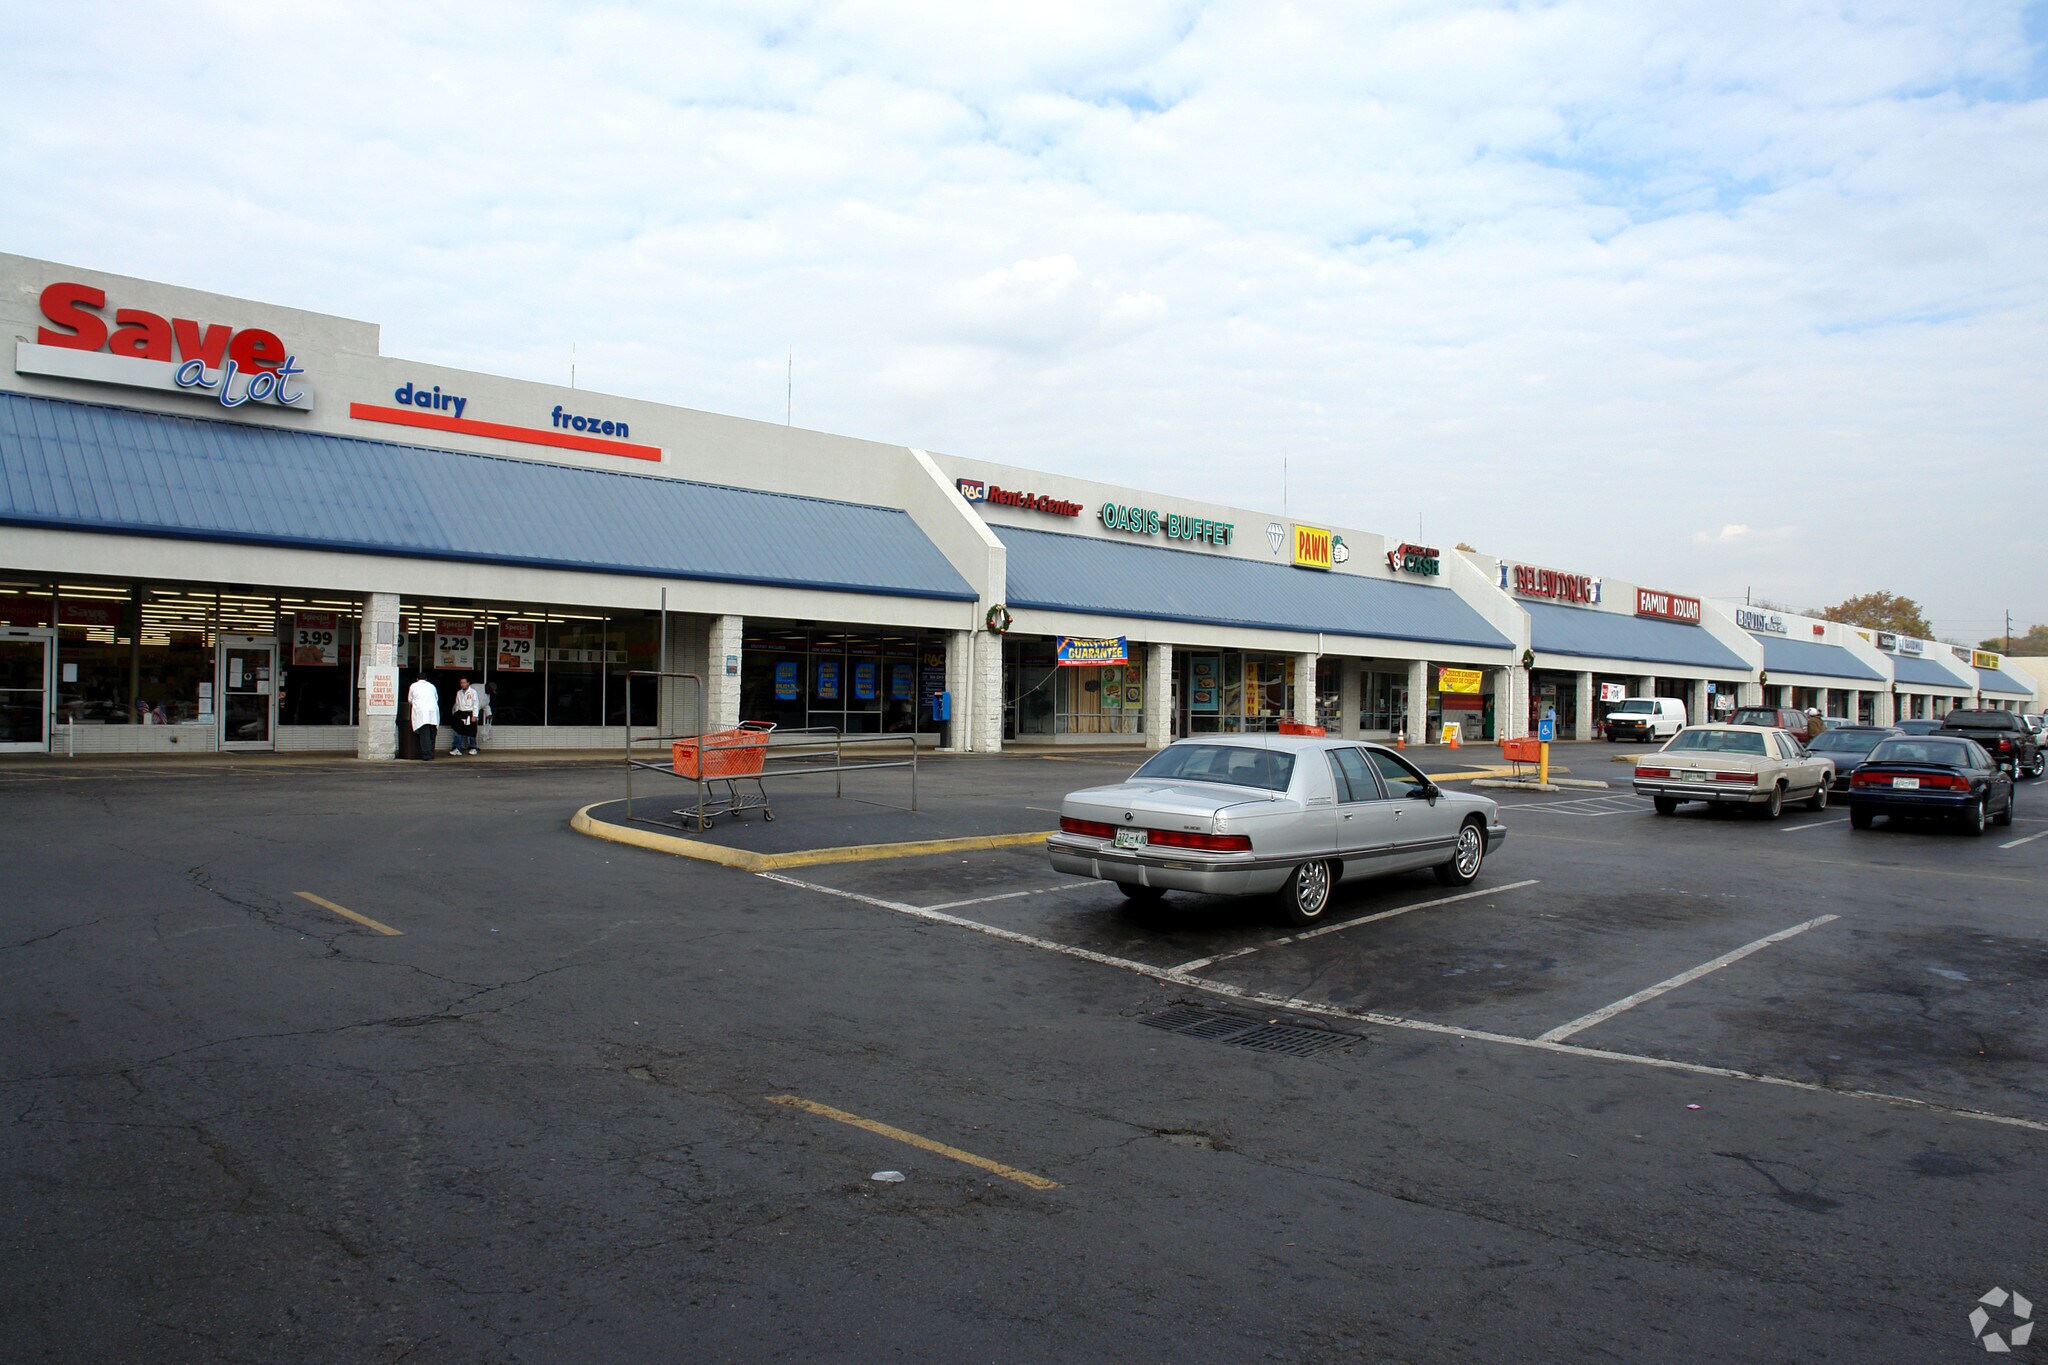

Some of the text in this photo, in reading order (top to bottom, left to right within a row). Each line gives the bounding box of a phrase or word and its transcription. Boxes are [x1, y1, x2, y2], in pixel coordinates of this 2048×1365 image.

[38, 282, 286, 377] Save
[176, 358, 219, 388] a
[394, 382, 467, 419] dairy
[551, 405, 629, 438] frozen
[961, 483, 983, 500] RAC
[1102, 502, 1235, 546] OASIS BUFFET
[1299, 530, 1329, 564] PAWN
[1405, 544, 1440, 558] CHECK INTO
[1515, 565, 1591, 604] BELEW DRUG
[67, 606, 109, 620] Save
[1640, 591, 1699, 620] FAMILY DOLLAR
[442, 620, 467, 630] Special
[505, 623, 529, 633] Special
[300, 631, 333, 646] 3.99
[440, 637, 469, 651] 2.29
[502, 640, 530, 654] 2.79
[924, 653, 945, 668] RAC
[1068, 646, 1122, 659] GUARANTEE
[1247, 664, 1256, 716] PAWN
